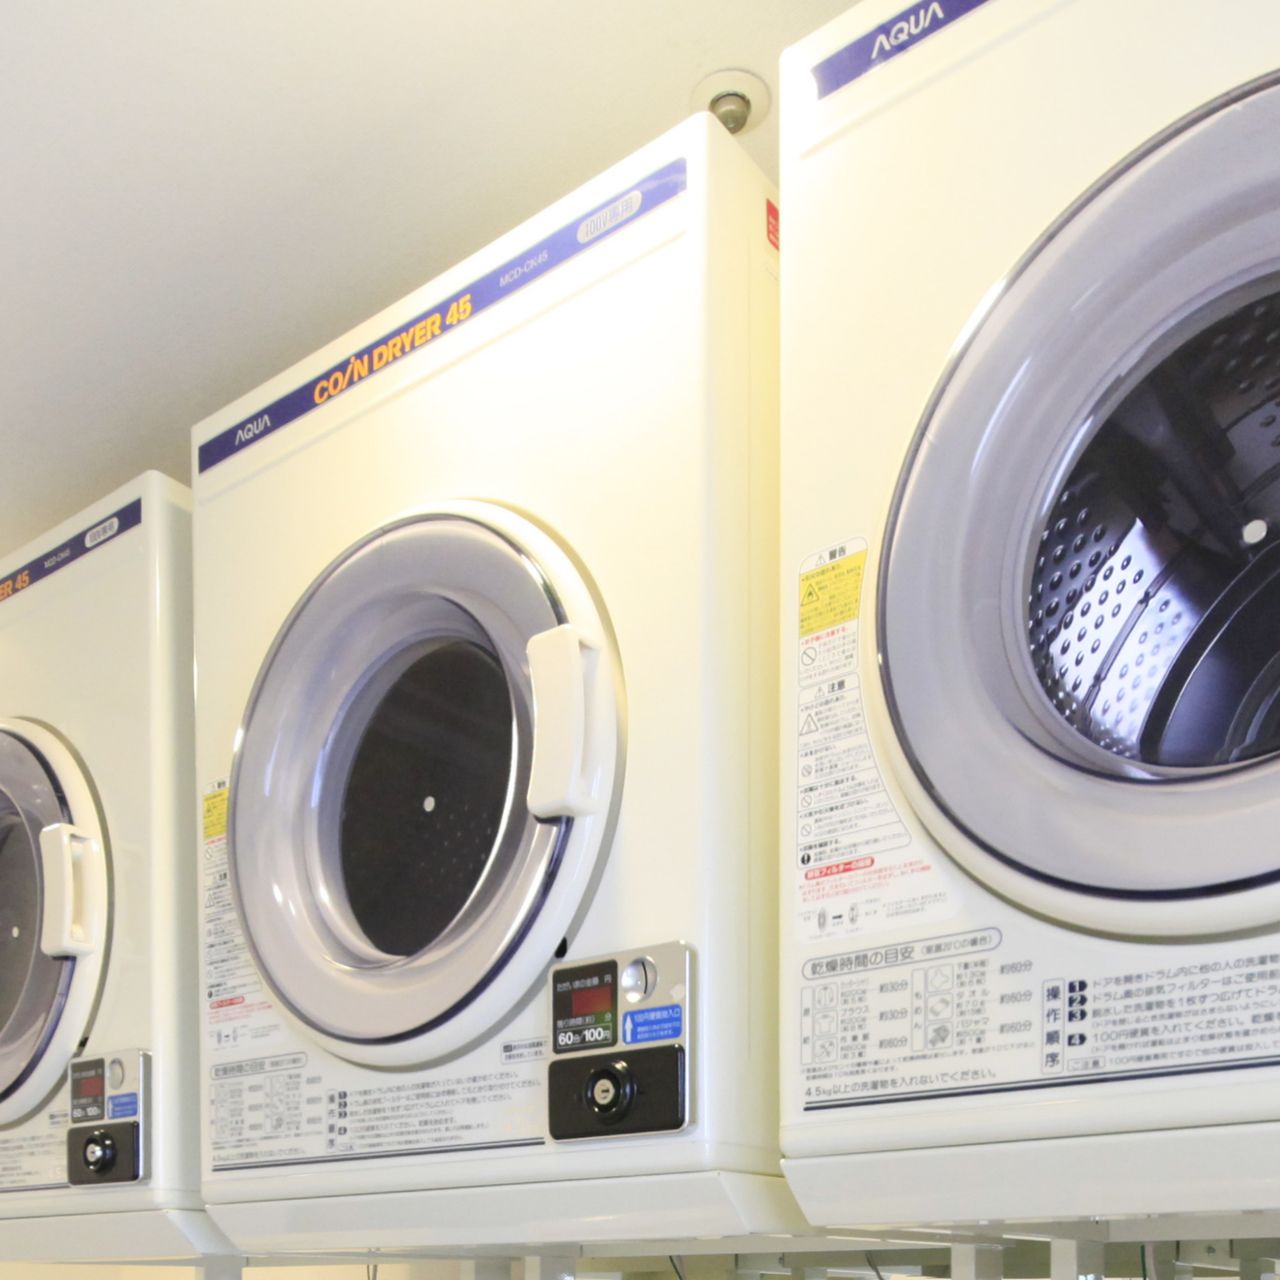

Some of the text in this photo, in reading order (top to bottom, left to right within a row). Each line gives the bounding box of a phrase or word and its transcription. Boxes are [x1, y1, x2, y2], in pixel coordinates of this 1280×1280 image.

[871, 1, 945, 60] AQUA
[234, 412, 271, 446] AQUA
[313, 356, 368, 406] COIN
[372, 312, 443, 373] DRYER
[444, 294, 473, 327] 45
[15, 570, 30, 590] 45
[810, 947, 916, 976] 乾燥時間の目安
